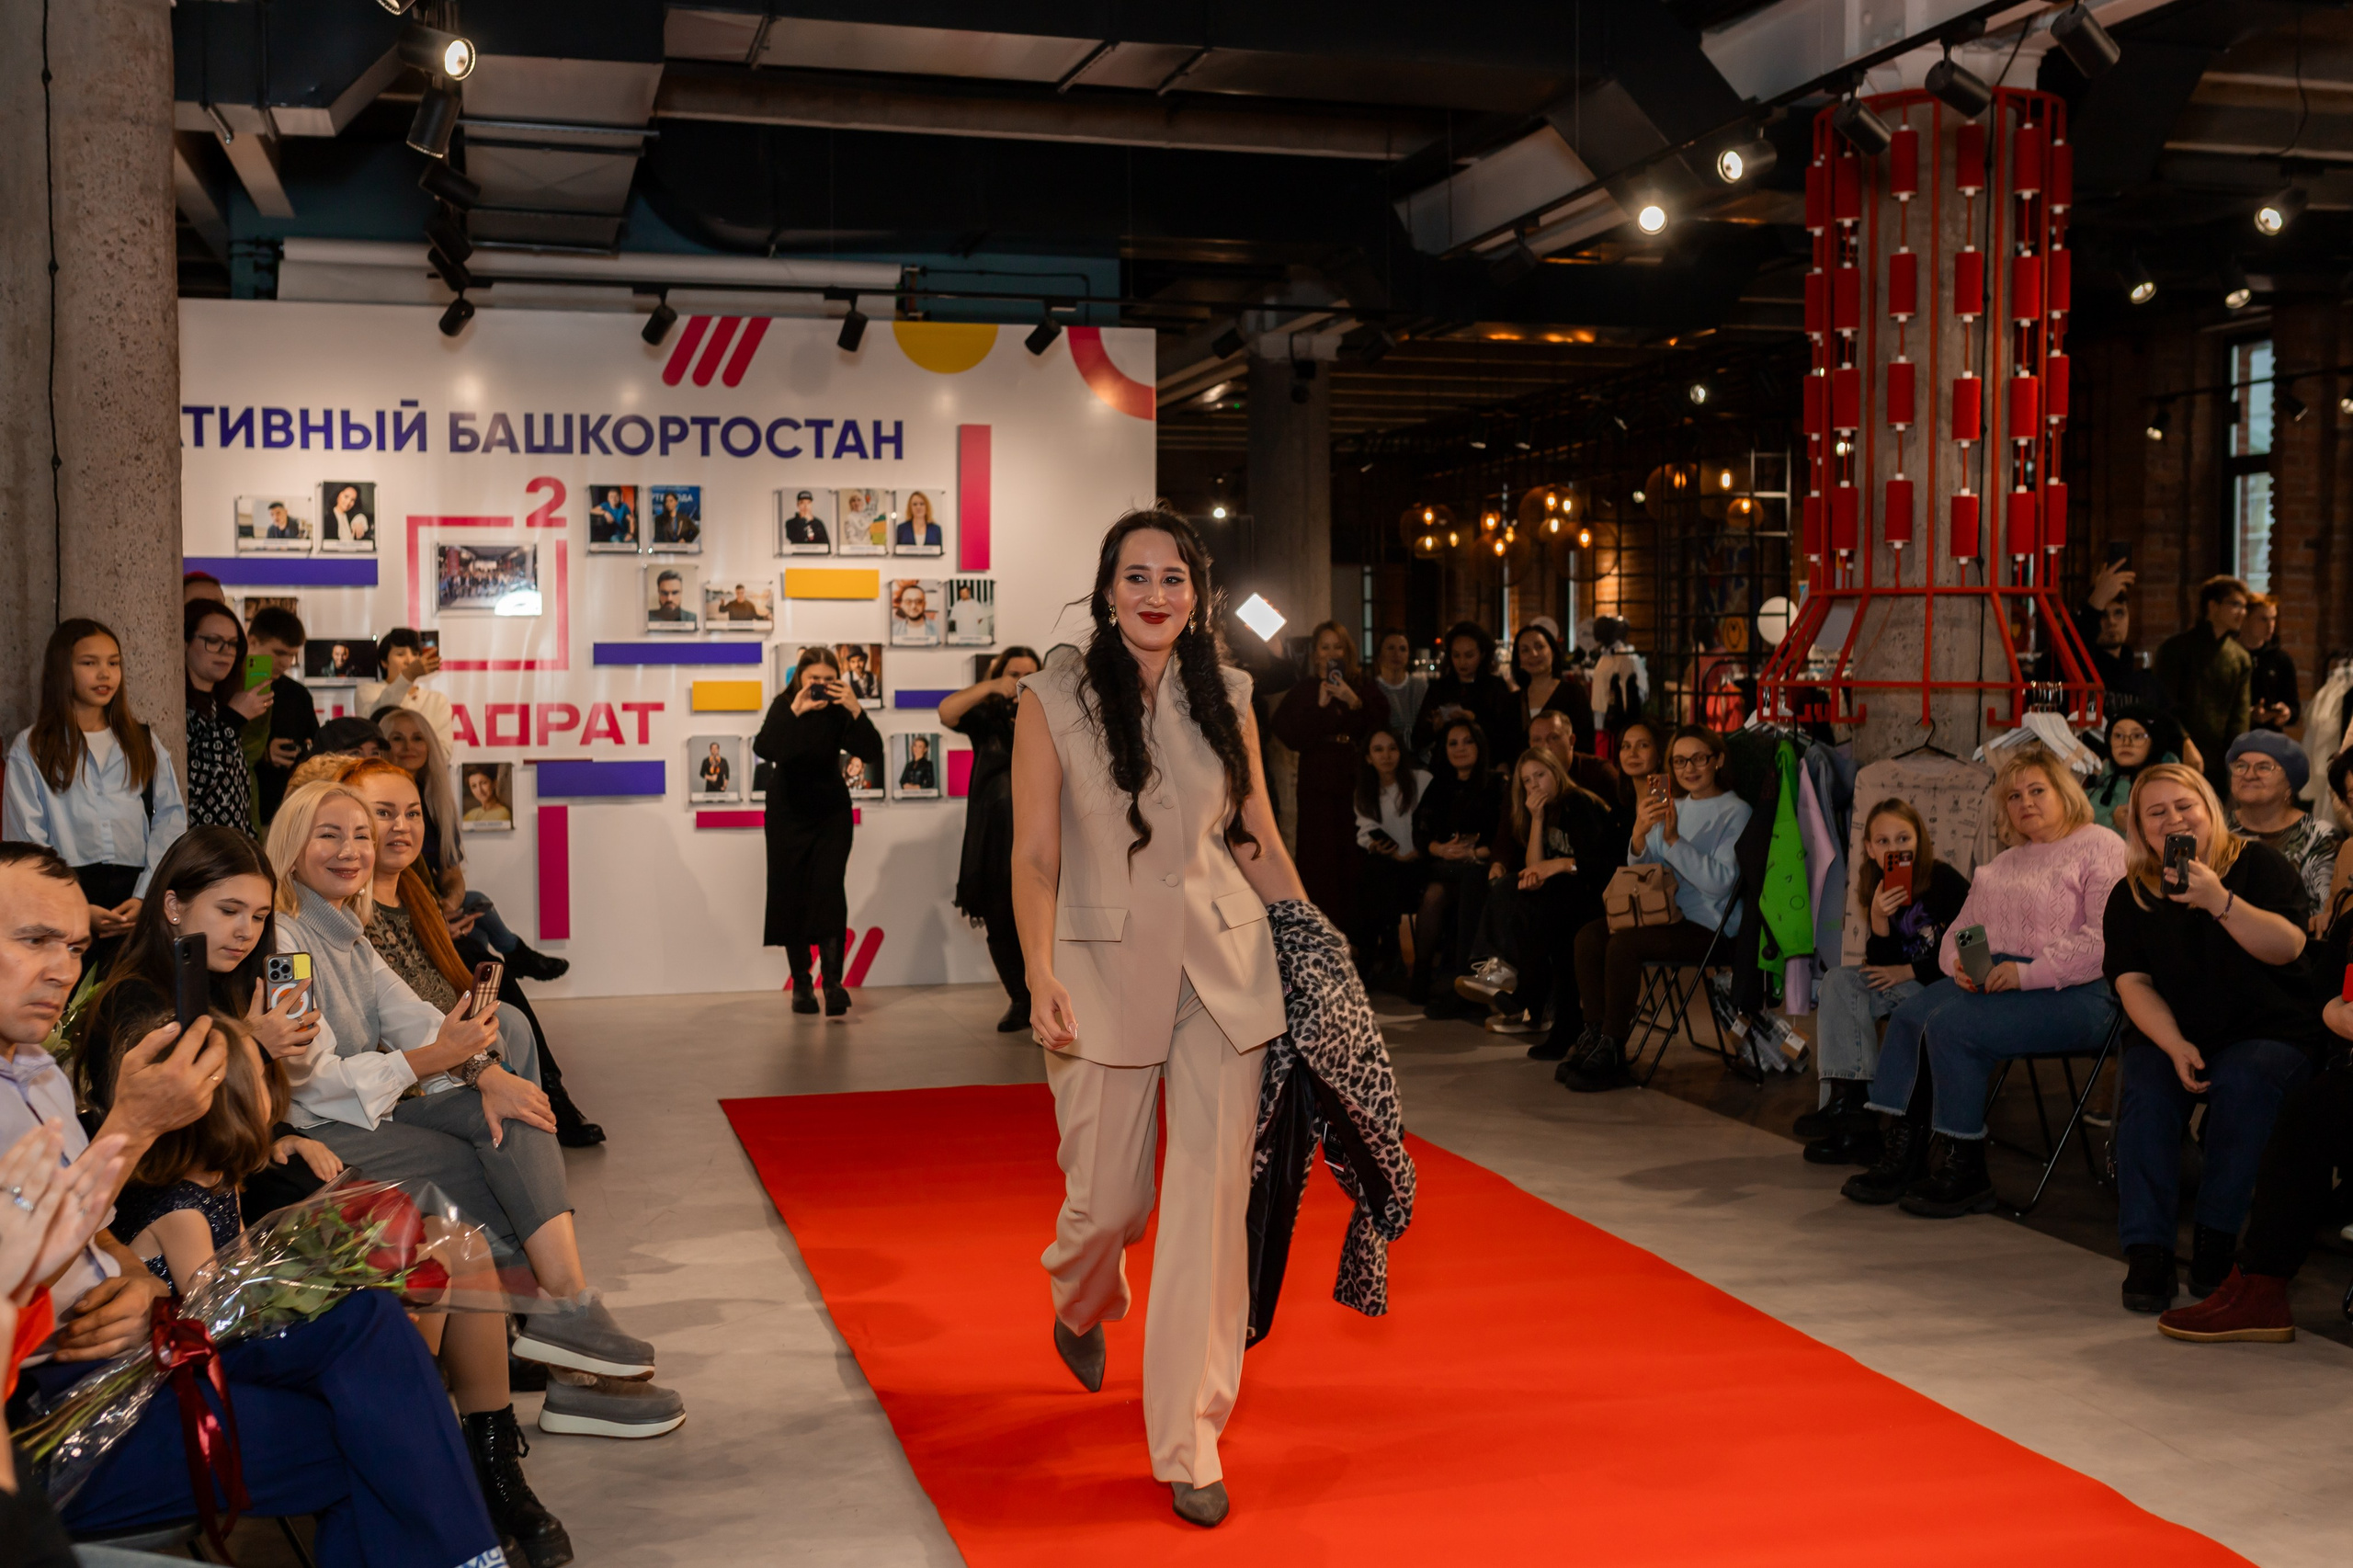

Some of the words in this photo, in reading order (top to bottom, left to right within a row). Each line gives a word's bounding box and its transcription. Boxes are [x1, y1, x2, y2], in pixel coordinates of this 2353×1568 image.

[181, 399, 426, 451] ТИВНЫЙ
[449, 411, 904, 460] БАШКОРТОСТАН
[526, 476, 566, 528] 2
